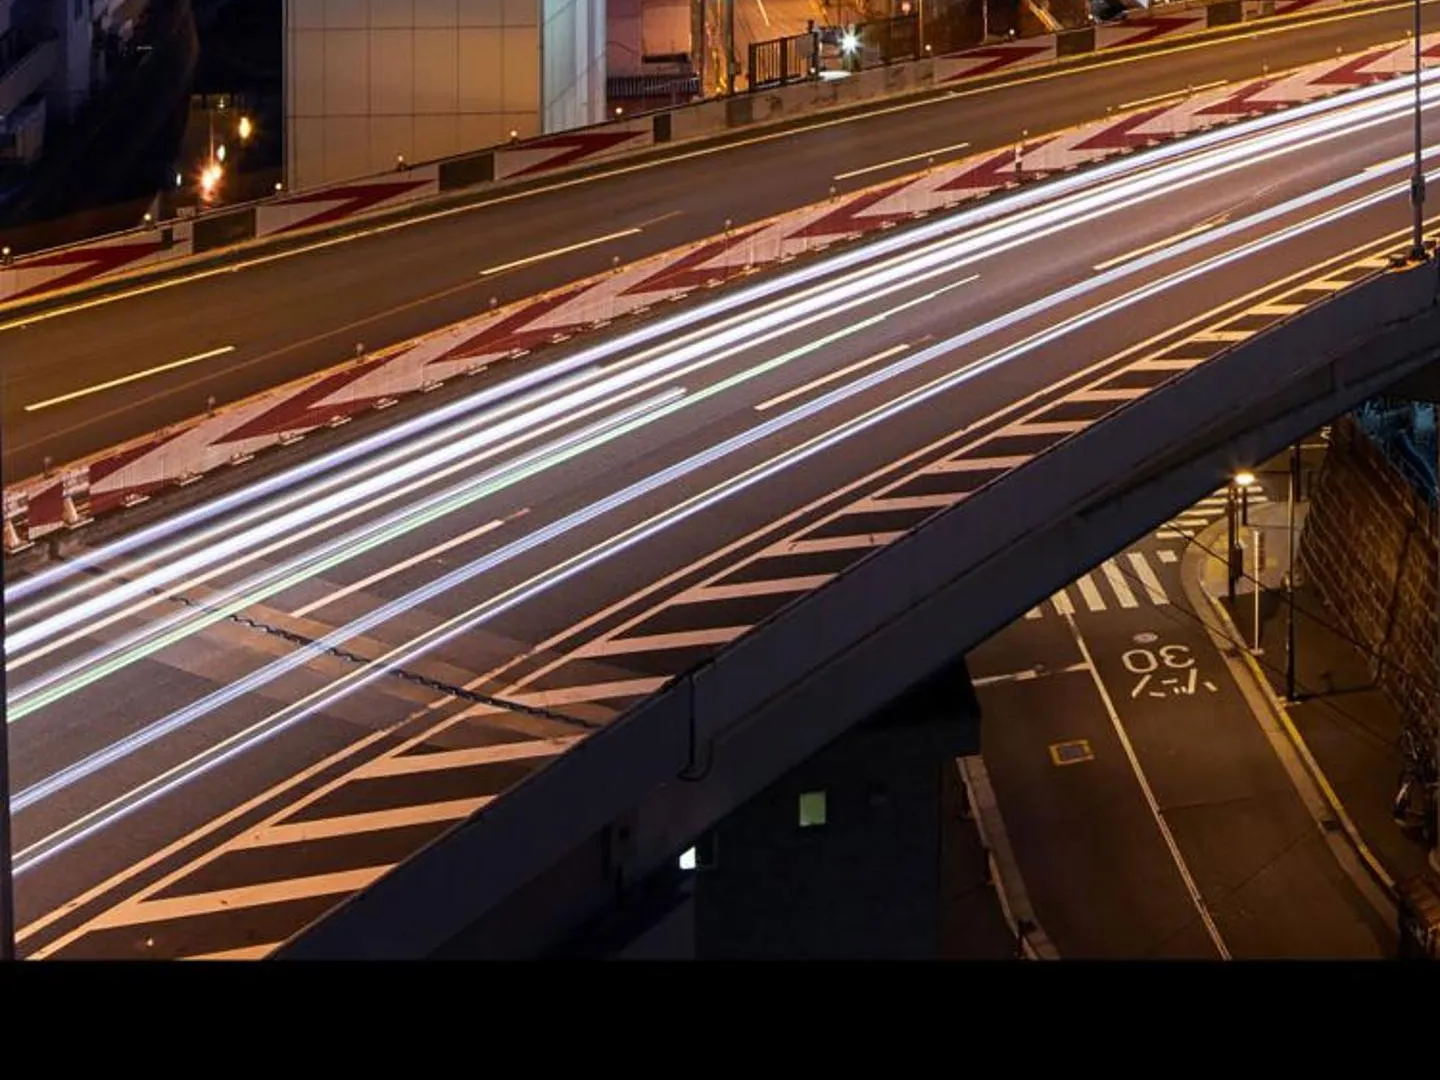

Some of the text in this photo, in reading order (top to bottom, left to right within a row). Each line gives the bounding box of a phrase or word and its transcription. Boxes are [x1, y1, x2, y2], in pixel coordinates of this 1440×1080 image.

[1121, 645, 1195, 673] 30
[1131, 668, 1218, 698] ゾーン
